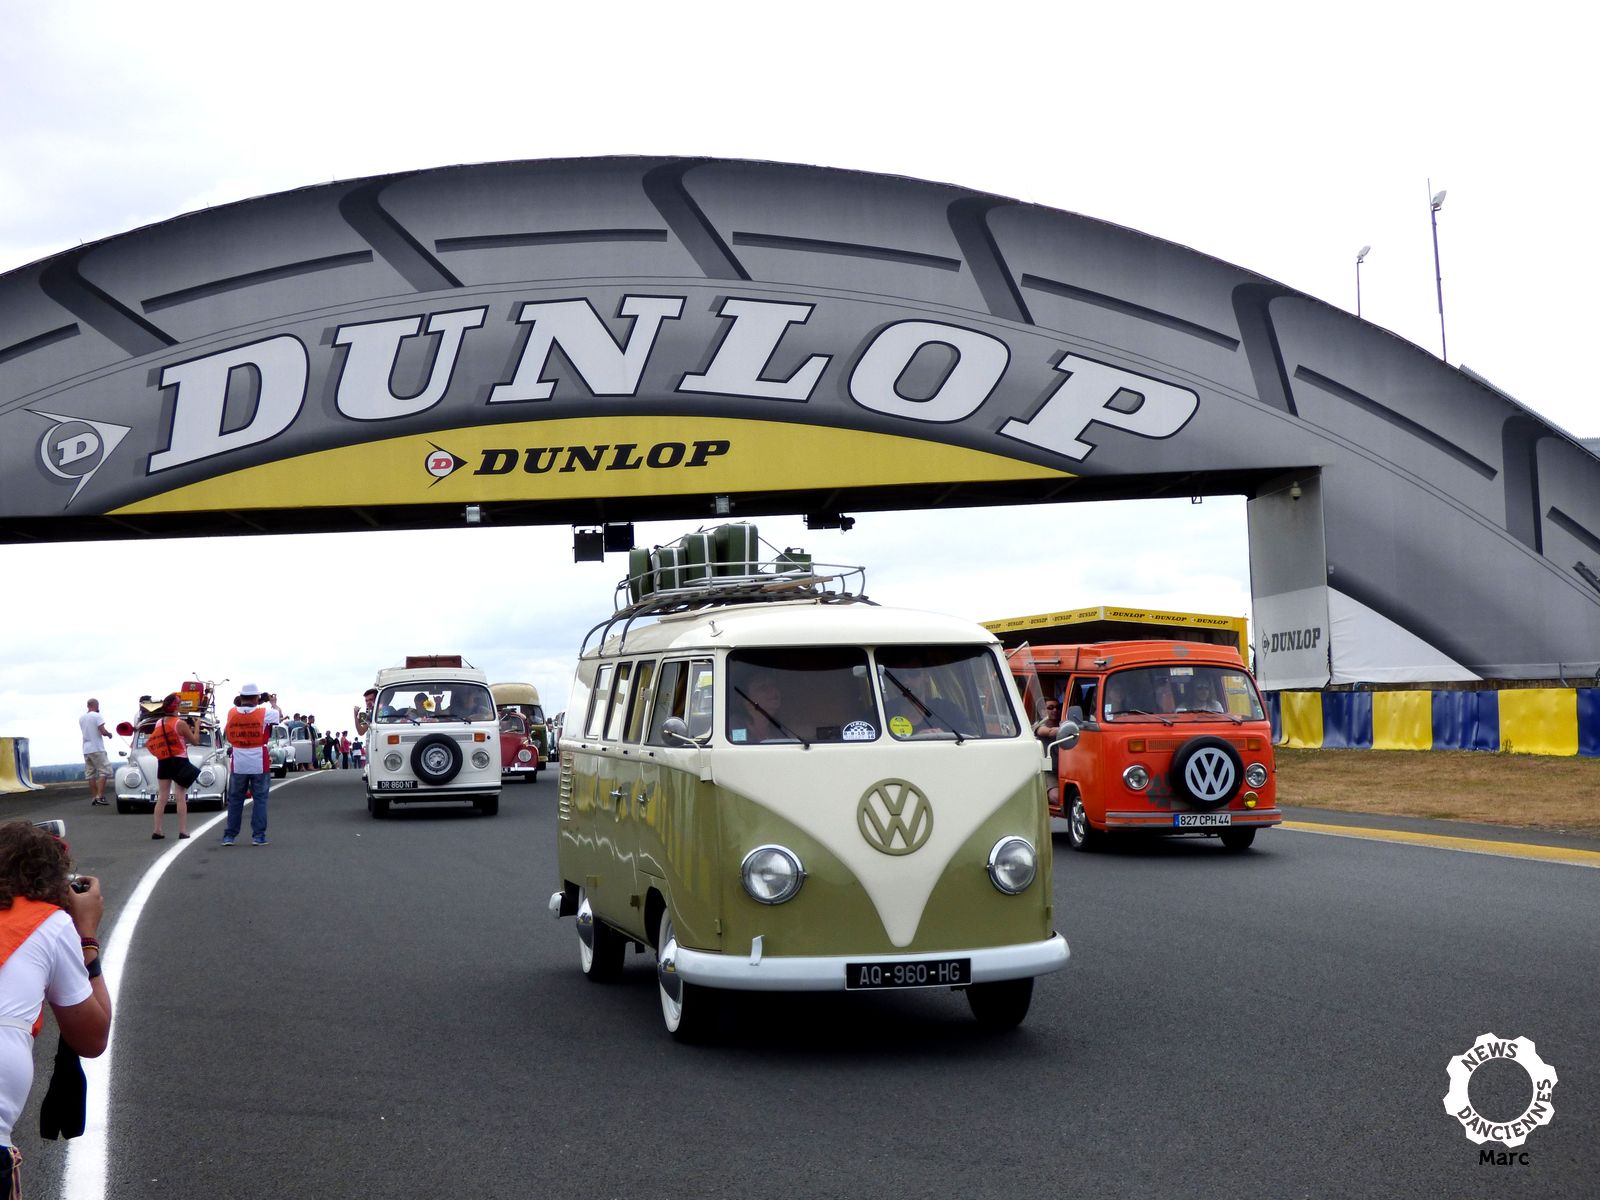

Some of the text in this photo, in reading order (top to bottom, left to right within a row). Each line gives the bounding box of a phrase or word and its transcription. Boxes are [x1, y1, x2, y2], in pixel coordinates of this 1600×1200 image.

[146, 294, 1200, 476] DUNLOP
[473, 440, 731, 476] DUNLOP
[1079, 611, 1098, 619] DUNLOP
[1112, 611, 1146, 619] DUNLOP
[1154, 614, 1188, 622] DUNLOP
[1270, 627, 1321, 653] DUNLOP
[1185, 747, 1235, 801] VW
[857, 778, 934, 856] VW
[1180, 815, 1230, 826] 827 CPH 44
